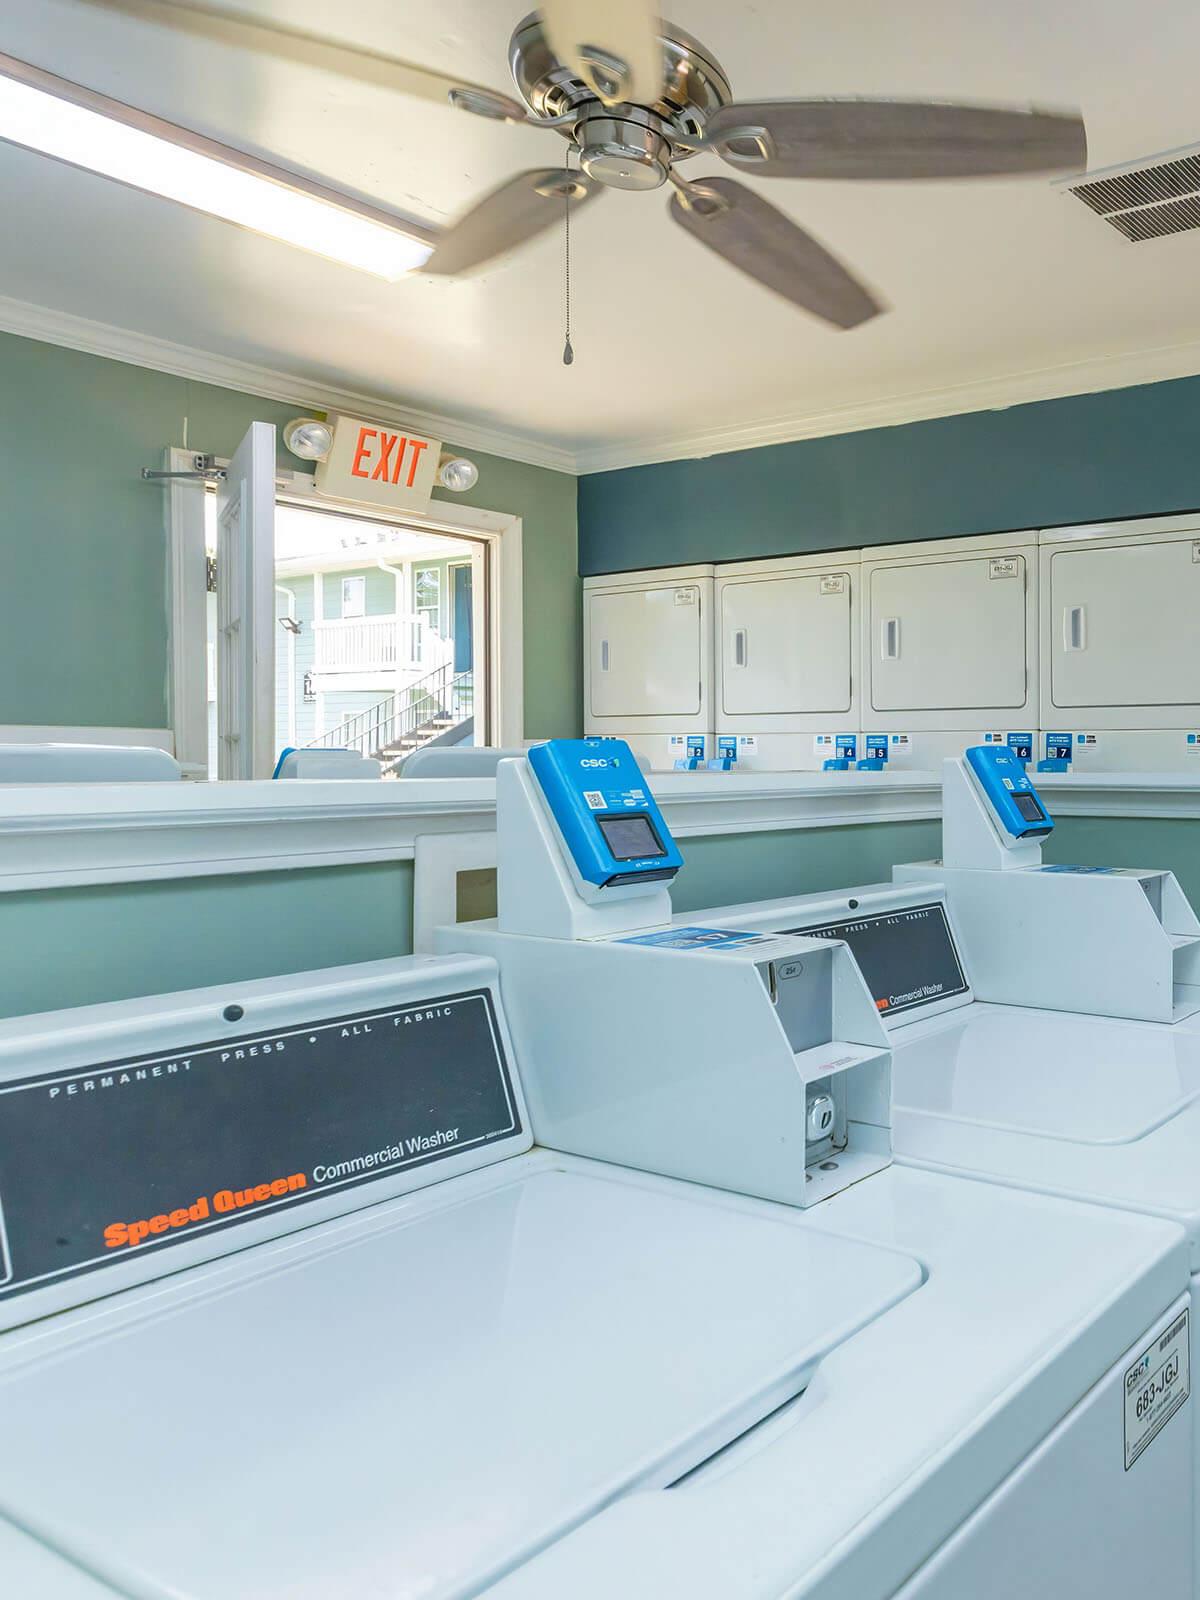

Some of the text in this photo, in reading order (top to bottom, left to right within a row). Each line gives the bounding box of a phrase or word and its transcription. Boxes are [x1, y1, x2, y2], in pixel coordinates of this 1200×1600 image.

[351, 427, 428, 487] EXIT
[696, 748, 702, 757] 2
[728, 749, 734, 757] 3
[846, 749, 852, 757] 4
[878, 749, 884, 757] 5
[1020, 748, 1027, 757] 6
[1060, 748, 1067, 757] 7
[580, 758, 609, 768] CSC
[889, 989, 922, 1006] Commercial
[921, 983, 943, 996] Washer
[49, 1006, 453, 1099] PERMANENT PRESS ALL FABRIC
[103, 1127, 460, 1249] Speed Queen Commercial Washer
[1136, 1355, 1180, 1419] 683-JGJ
